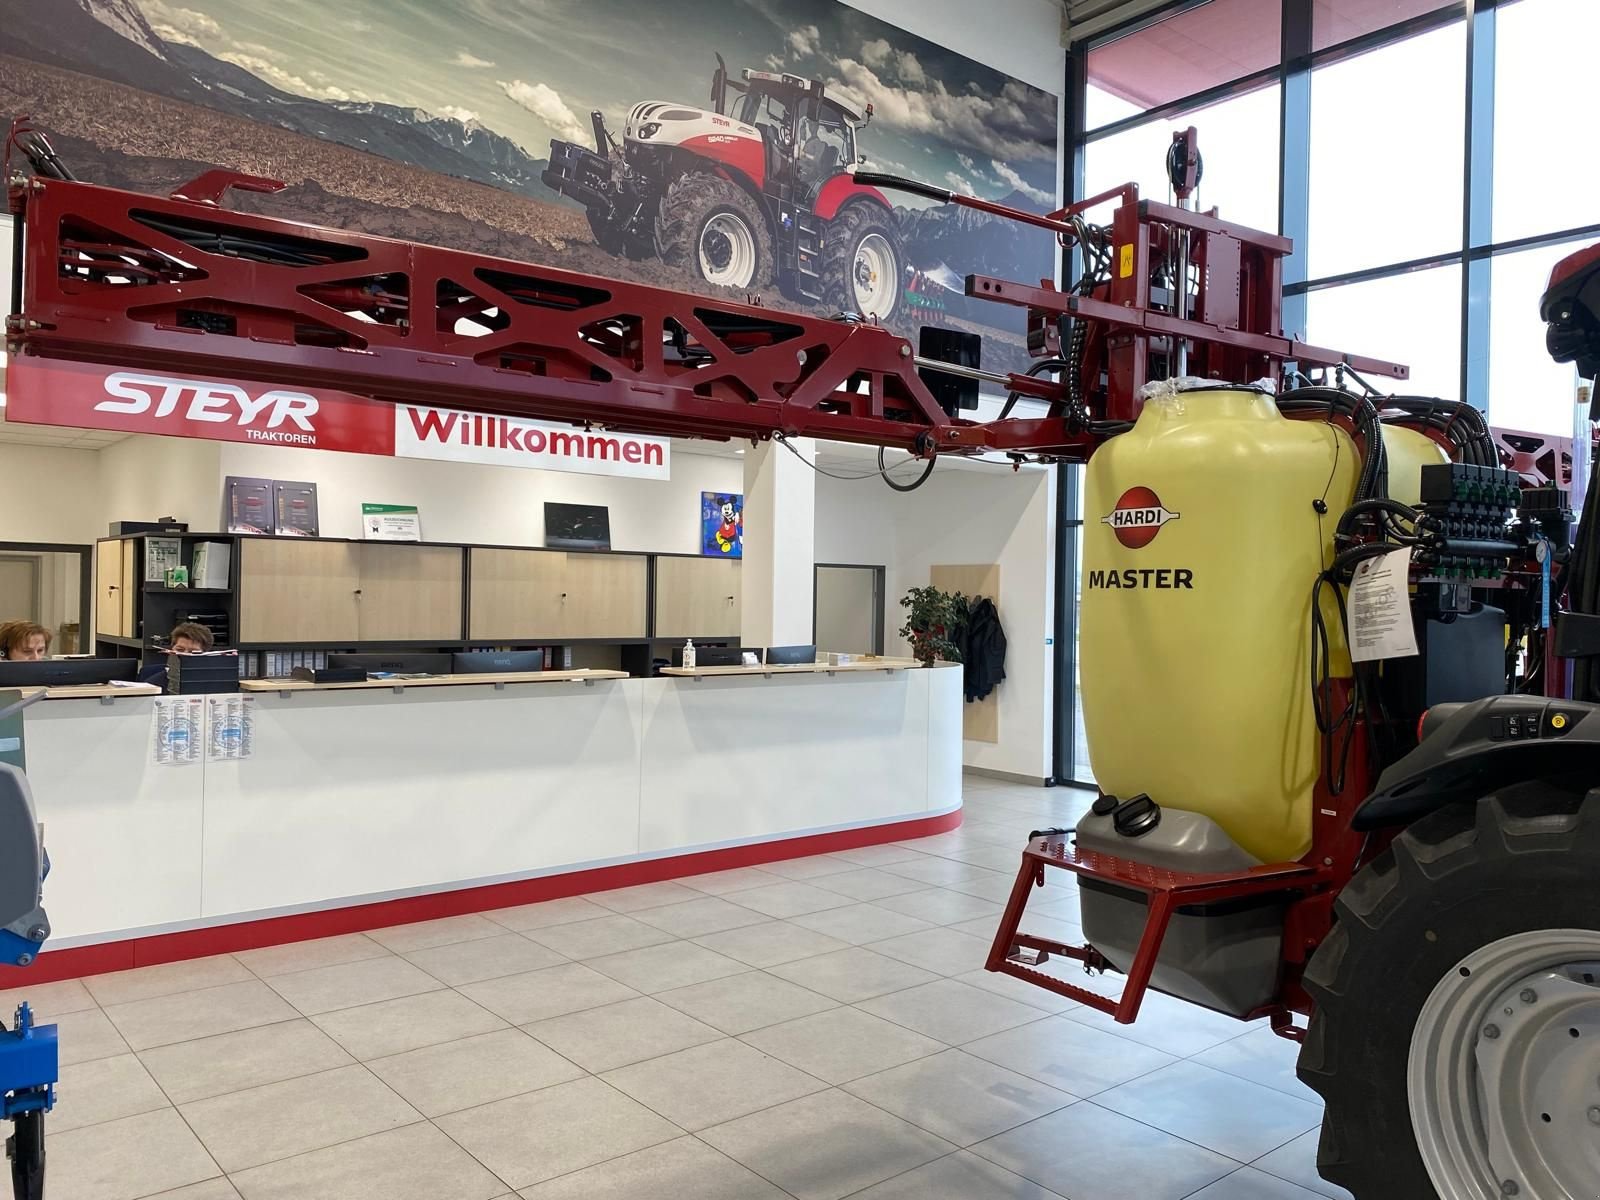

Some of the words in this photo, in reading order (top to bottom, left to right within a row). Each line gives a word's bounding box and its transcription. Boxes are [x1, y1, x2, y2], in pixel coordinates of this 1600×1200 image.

[94, 372, 319, 432] STEYR
[246, 429, 316, 444] TRAKTOREN
[407, 407, 663, 466] Willkommen
[1114, 509, 1161, 526] HARDI
[1089, 569, 1194, 590] MASTER
